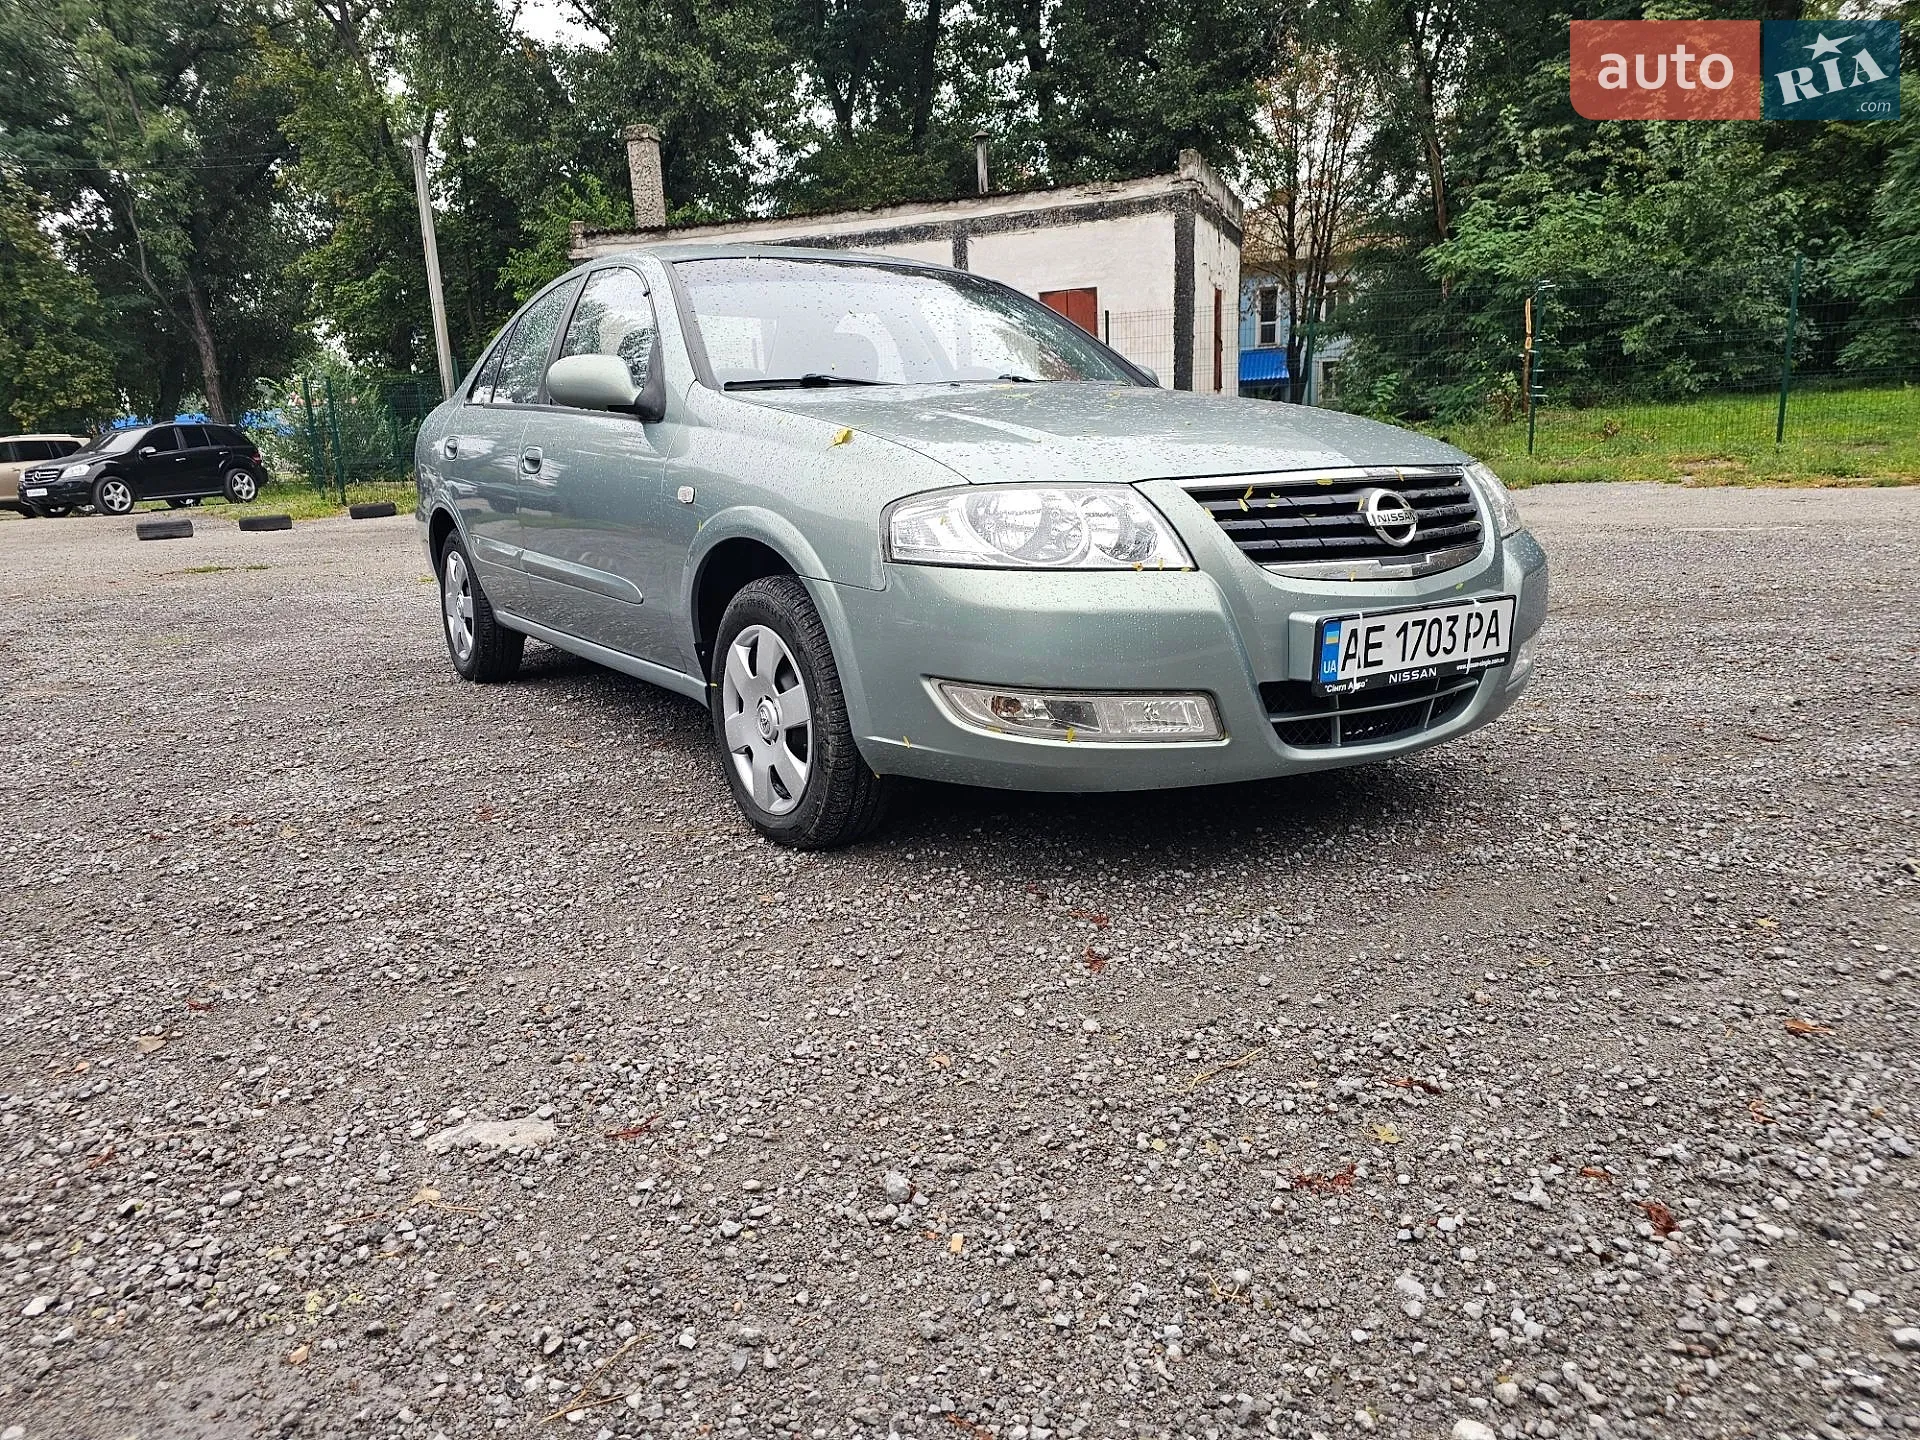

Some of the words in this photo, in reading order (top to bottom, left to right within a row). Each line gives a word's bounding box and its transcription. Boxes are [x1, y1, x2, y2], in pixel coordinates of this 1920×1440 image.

[1376, 511, 1417, 523] NISSAN
[1340, 624, 1386, 672] AE
[1395, 614, 1460, 663] 1703
[1464, 609, 1500, 653] PA
[1323, 660, 1337, 674] UA
[1388, 667, 1437, 684] NISSAN
